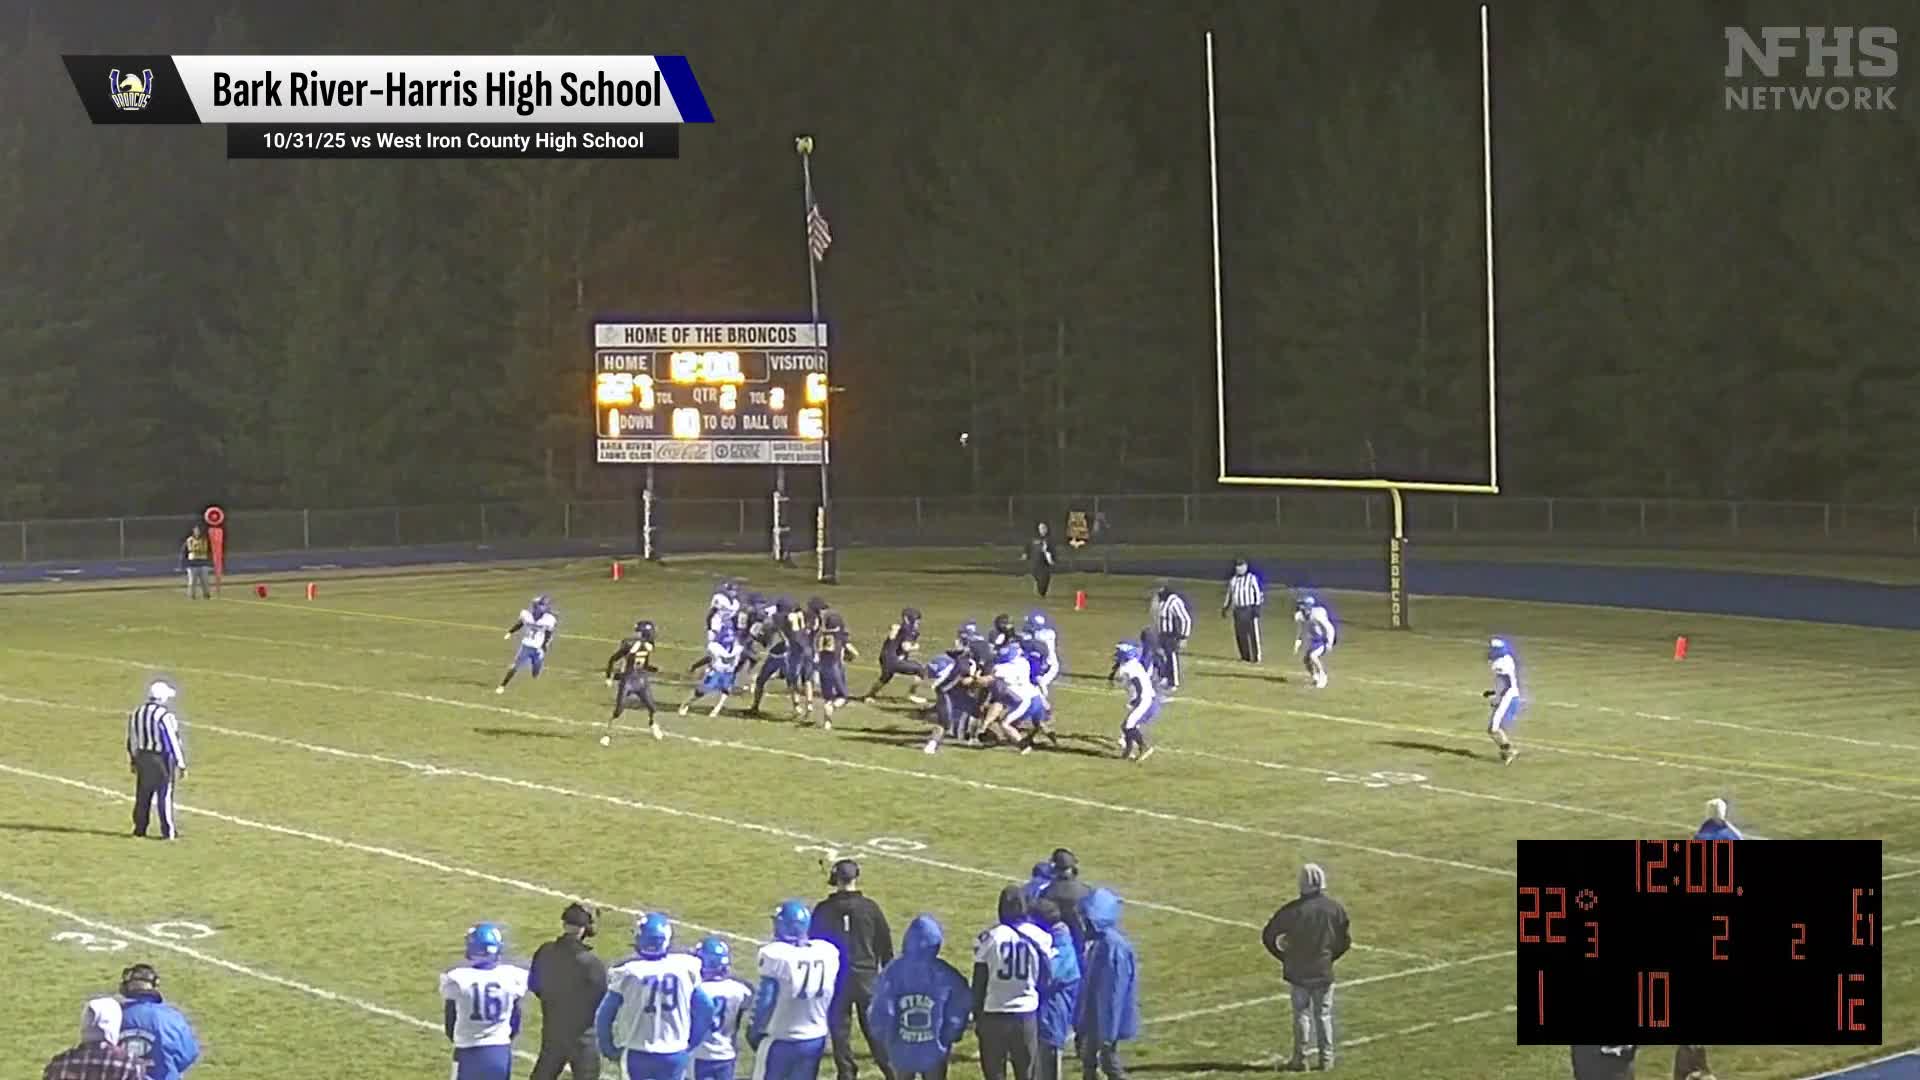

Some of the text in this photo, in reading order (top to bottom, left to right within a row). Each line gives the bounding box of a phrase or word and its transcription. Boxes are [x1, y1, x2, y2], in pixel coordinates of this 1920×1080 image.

[625, 327, 797, 343] HOME OF THE BRONCOS
[604, 355, 648, 370] HOME
[693, 387, 718, 404] QTR
[620, 414, 654, 430] DOWN
[702, 415, 736, 430] TO GO
[772, 415, 788, 430] ON
[996, 940, 1029, 981] 30
[797, 960, 826, 999] 77
[641, 972, 680, 1013] 79
[469, 981, 505, 1022] 16
